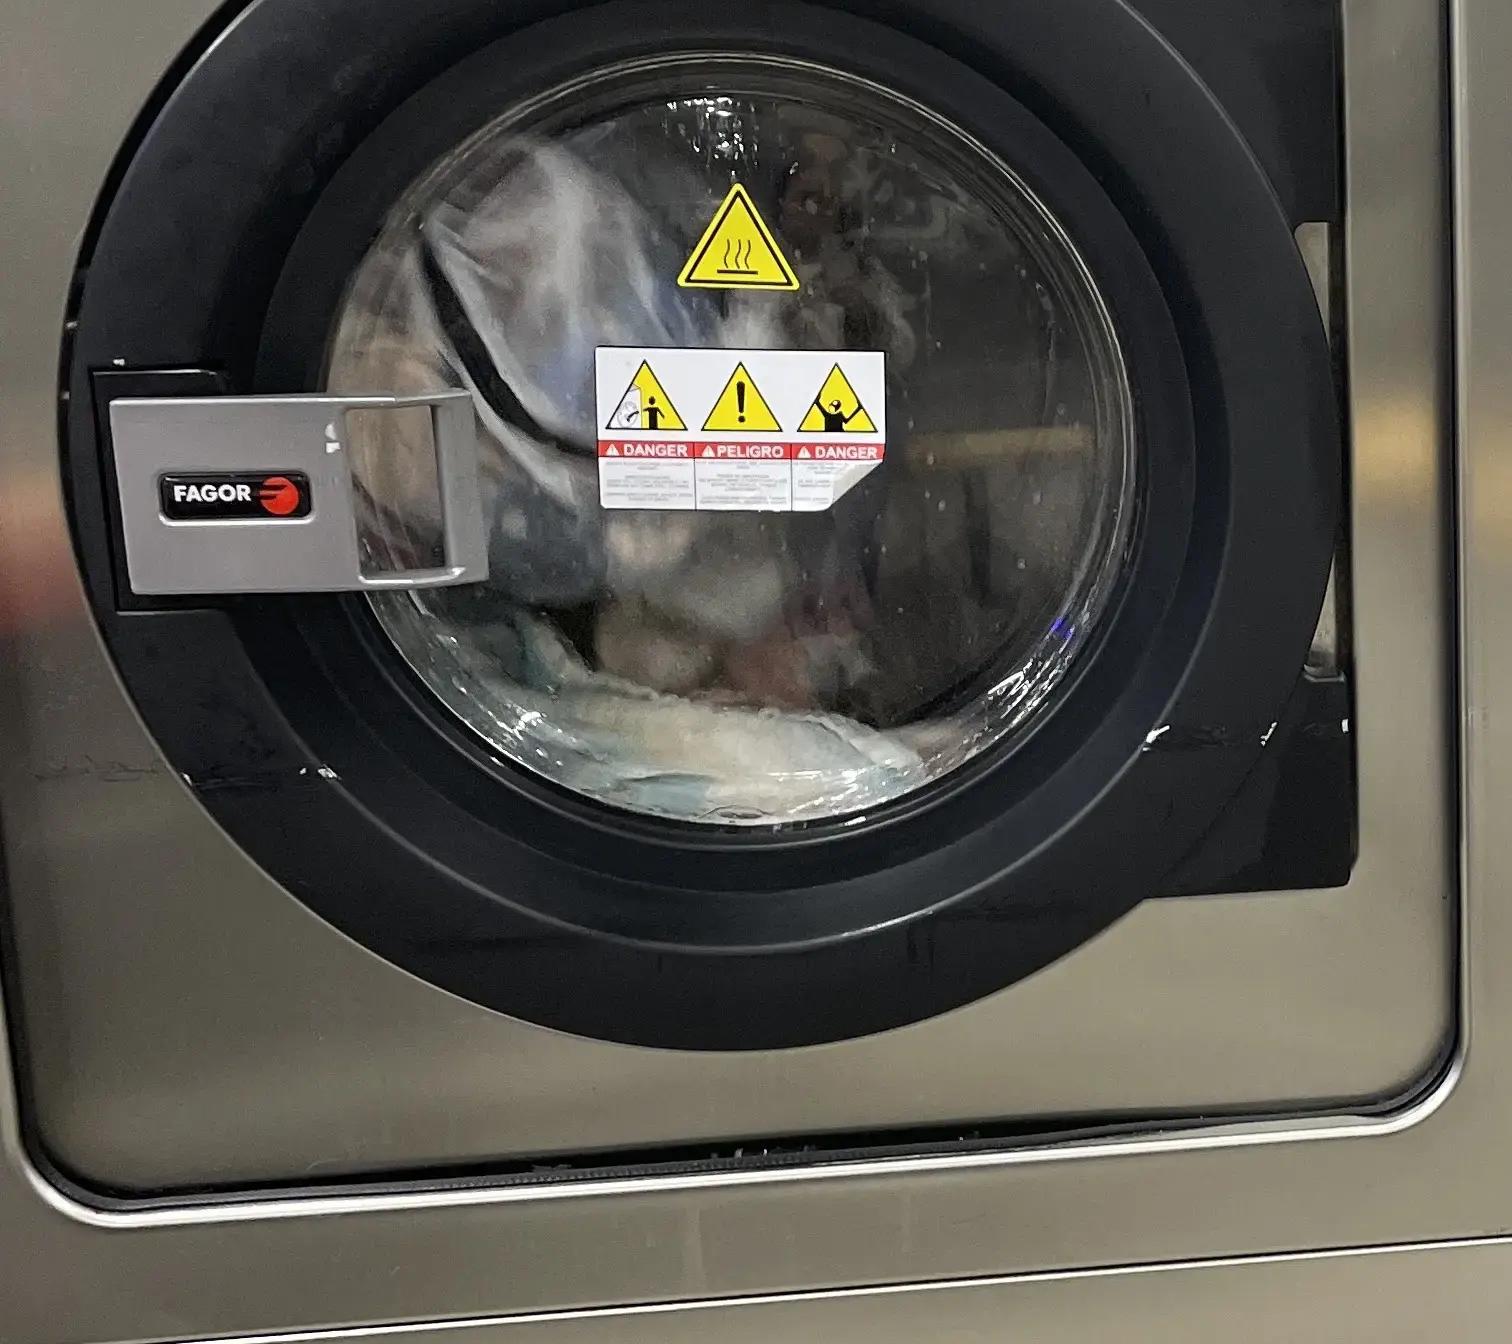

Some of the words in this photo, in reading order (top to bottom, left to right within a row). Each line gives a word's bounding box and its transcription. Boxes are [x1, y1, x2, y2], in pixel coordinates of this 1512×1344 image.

[623, 444, 688, 456] DANGER
[717, 445, 784, 457] PELIGRO
[815, 446, 878, 459] DANGER
[173, 484, 252, 503] FAGOR
